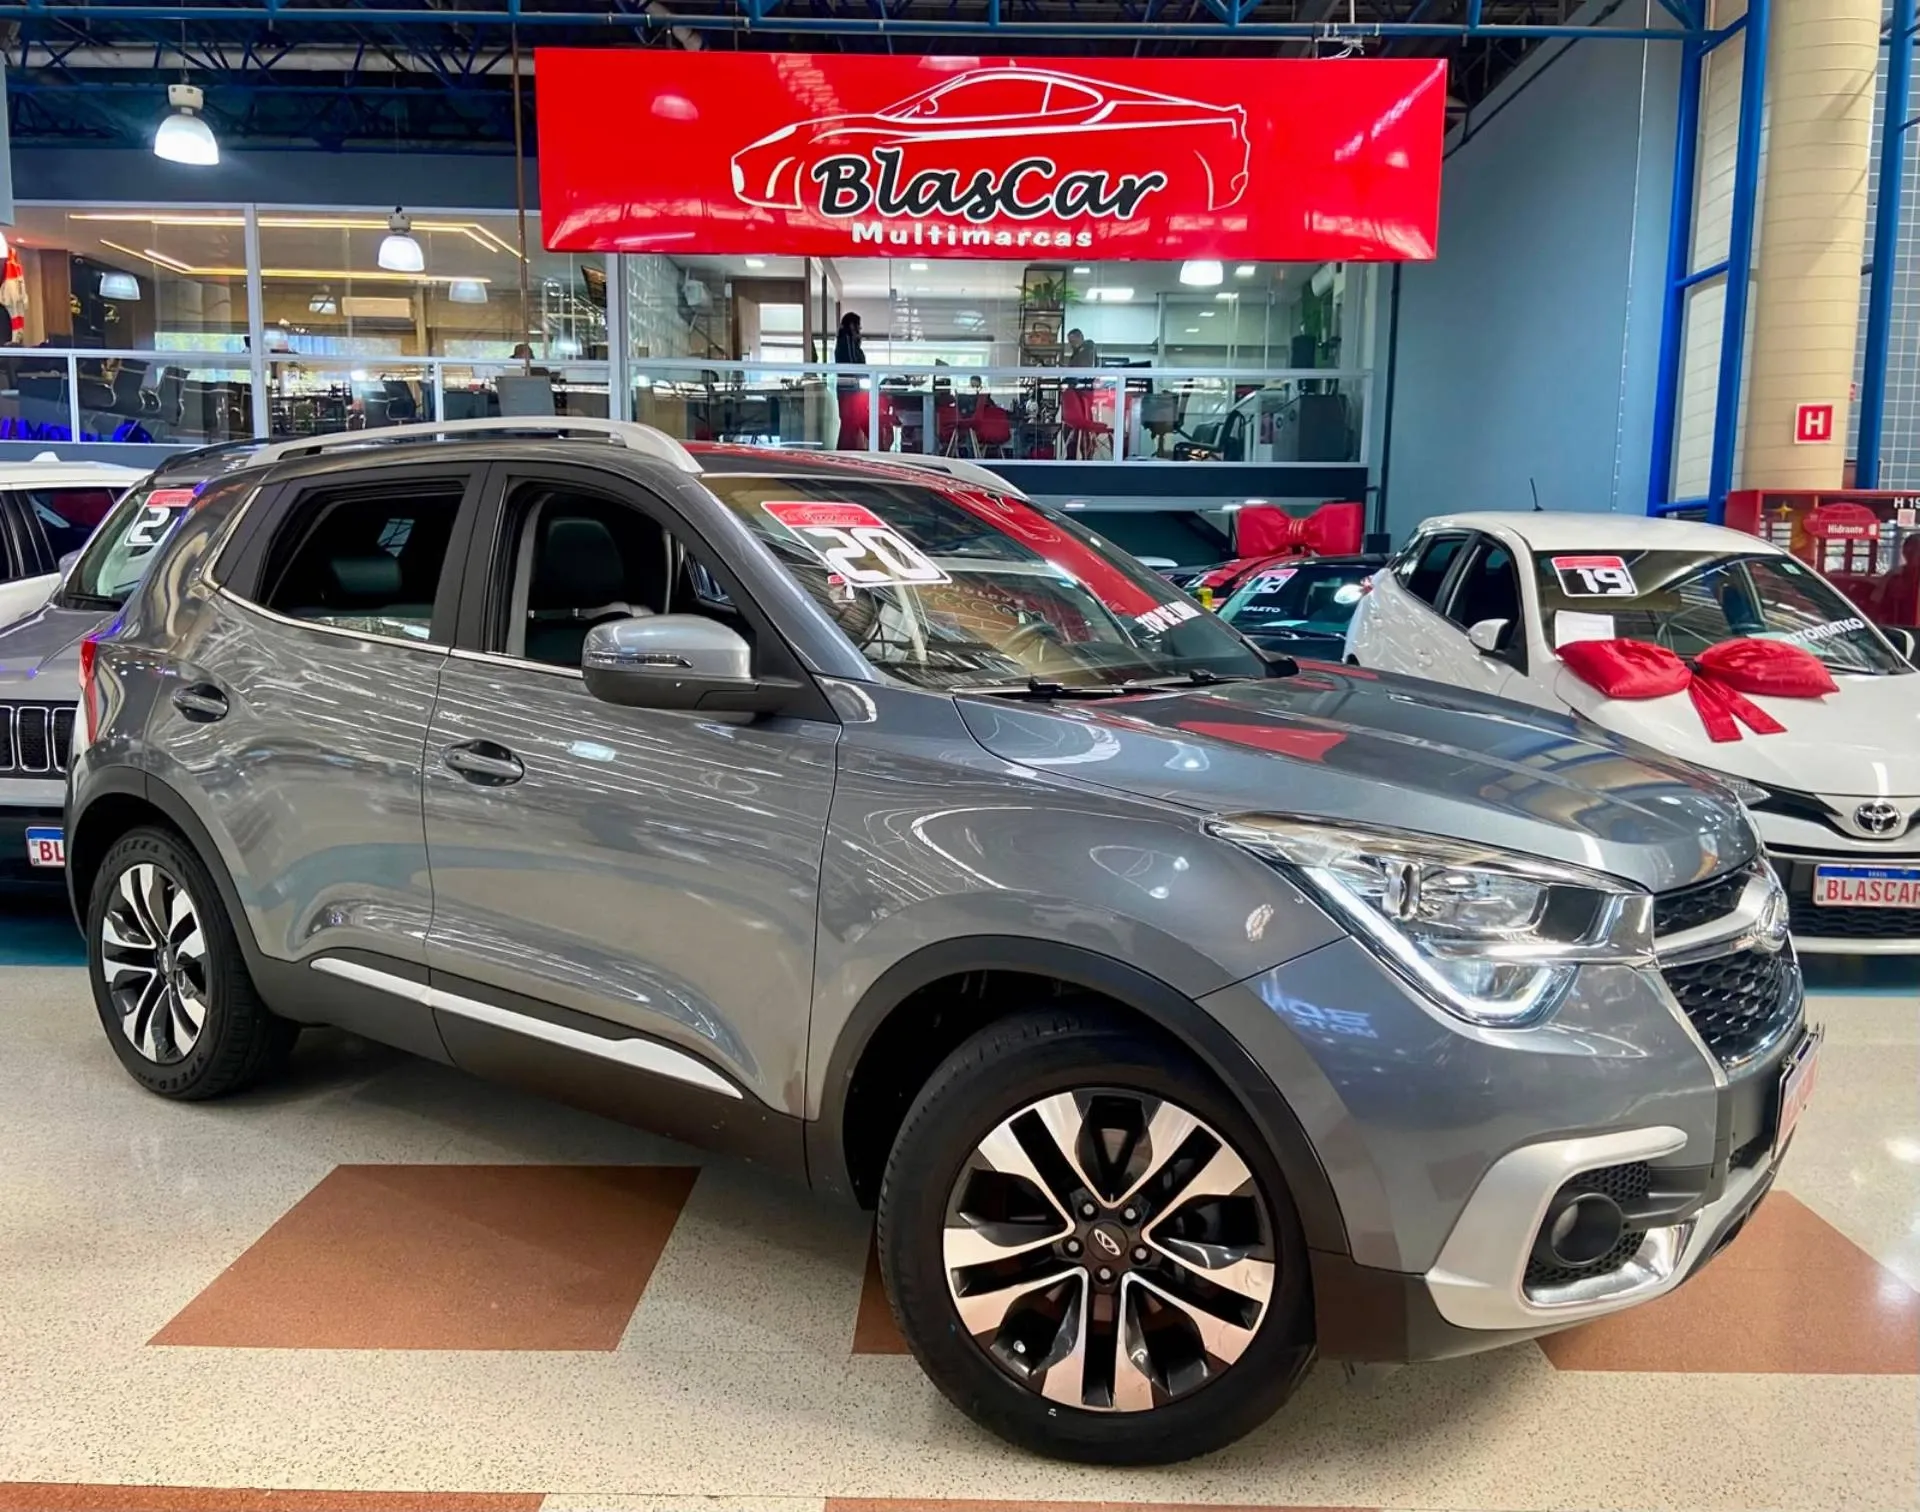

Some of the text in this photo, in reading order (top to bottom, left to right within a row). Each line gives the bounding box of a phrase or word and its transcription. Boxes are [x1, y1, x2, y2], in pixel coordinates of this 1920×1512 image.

[811, 147, 1167, 223] BlasCar
[852, 221, 1093, 247] Multimarcas
[1805, 411, 1825, 435] H
[1894, 496, 1904, 509] H
[129, 507, 170, 542] 2
[1828, 523, 1864, 534] Hidrante
[803, 528, 941, 582] 20
[1577, 569, 1633, 593] 19
